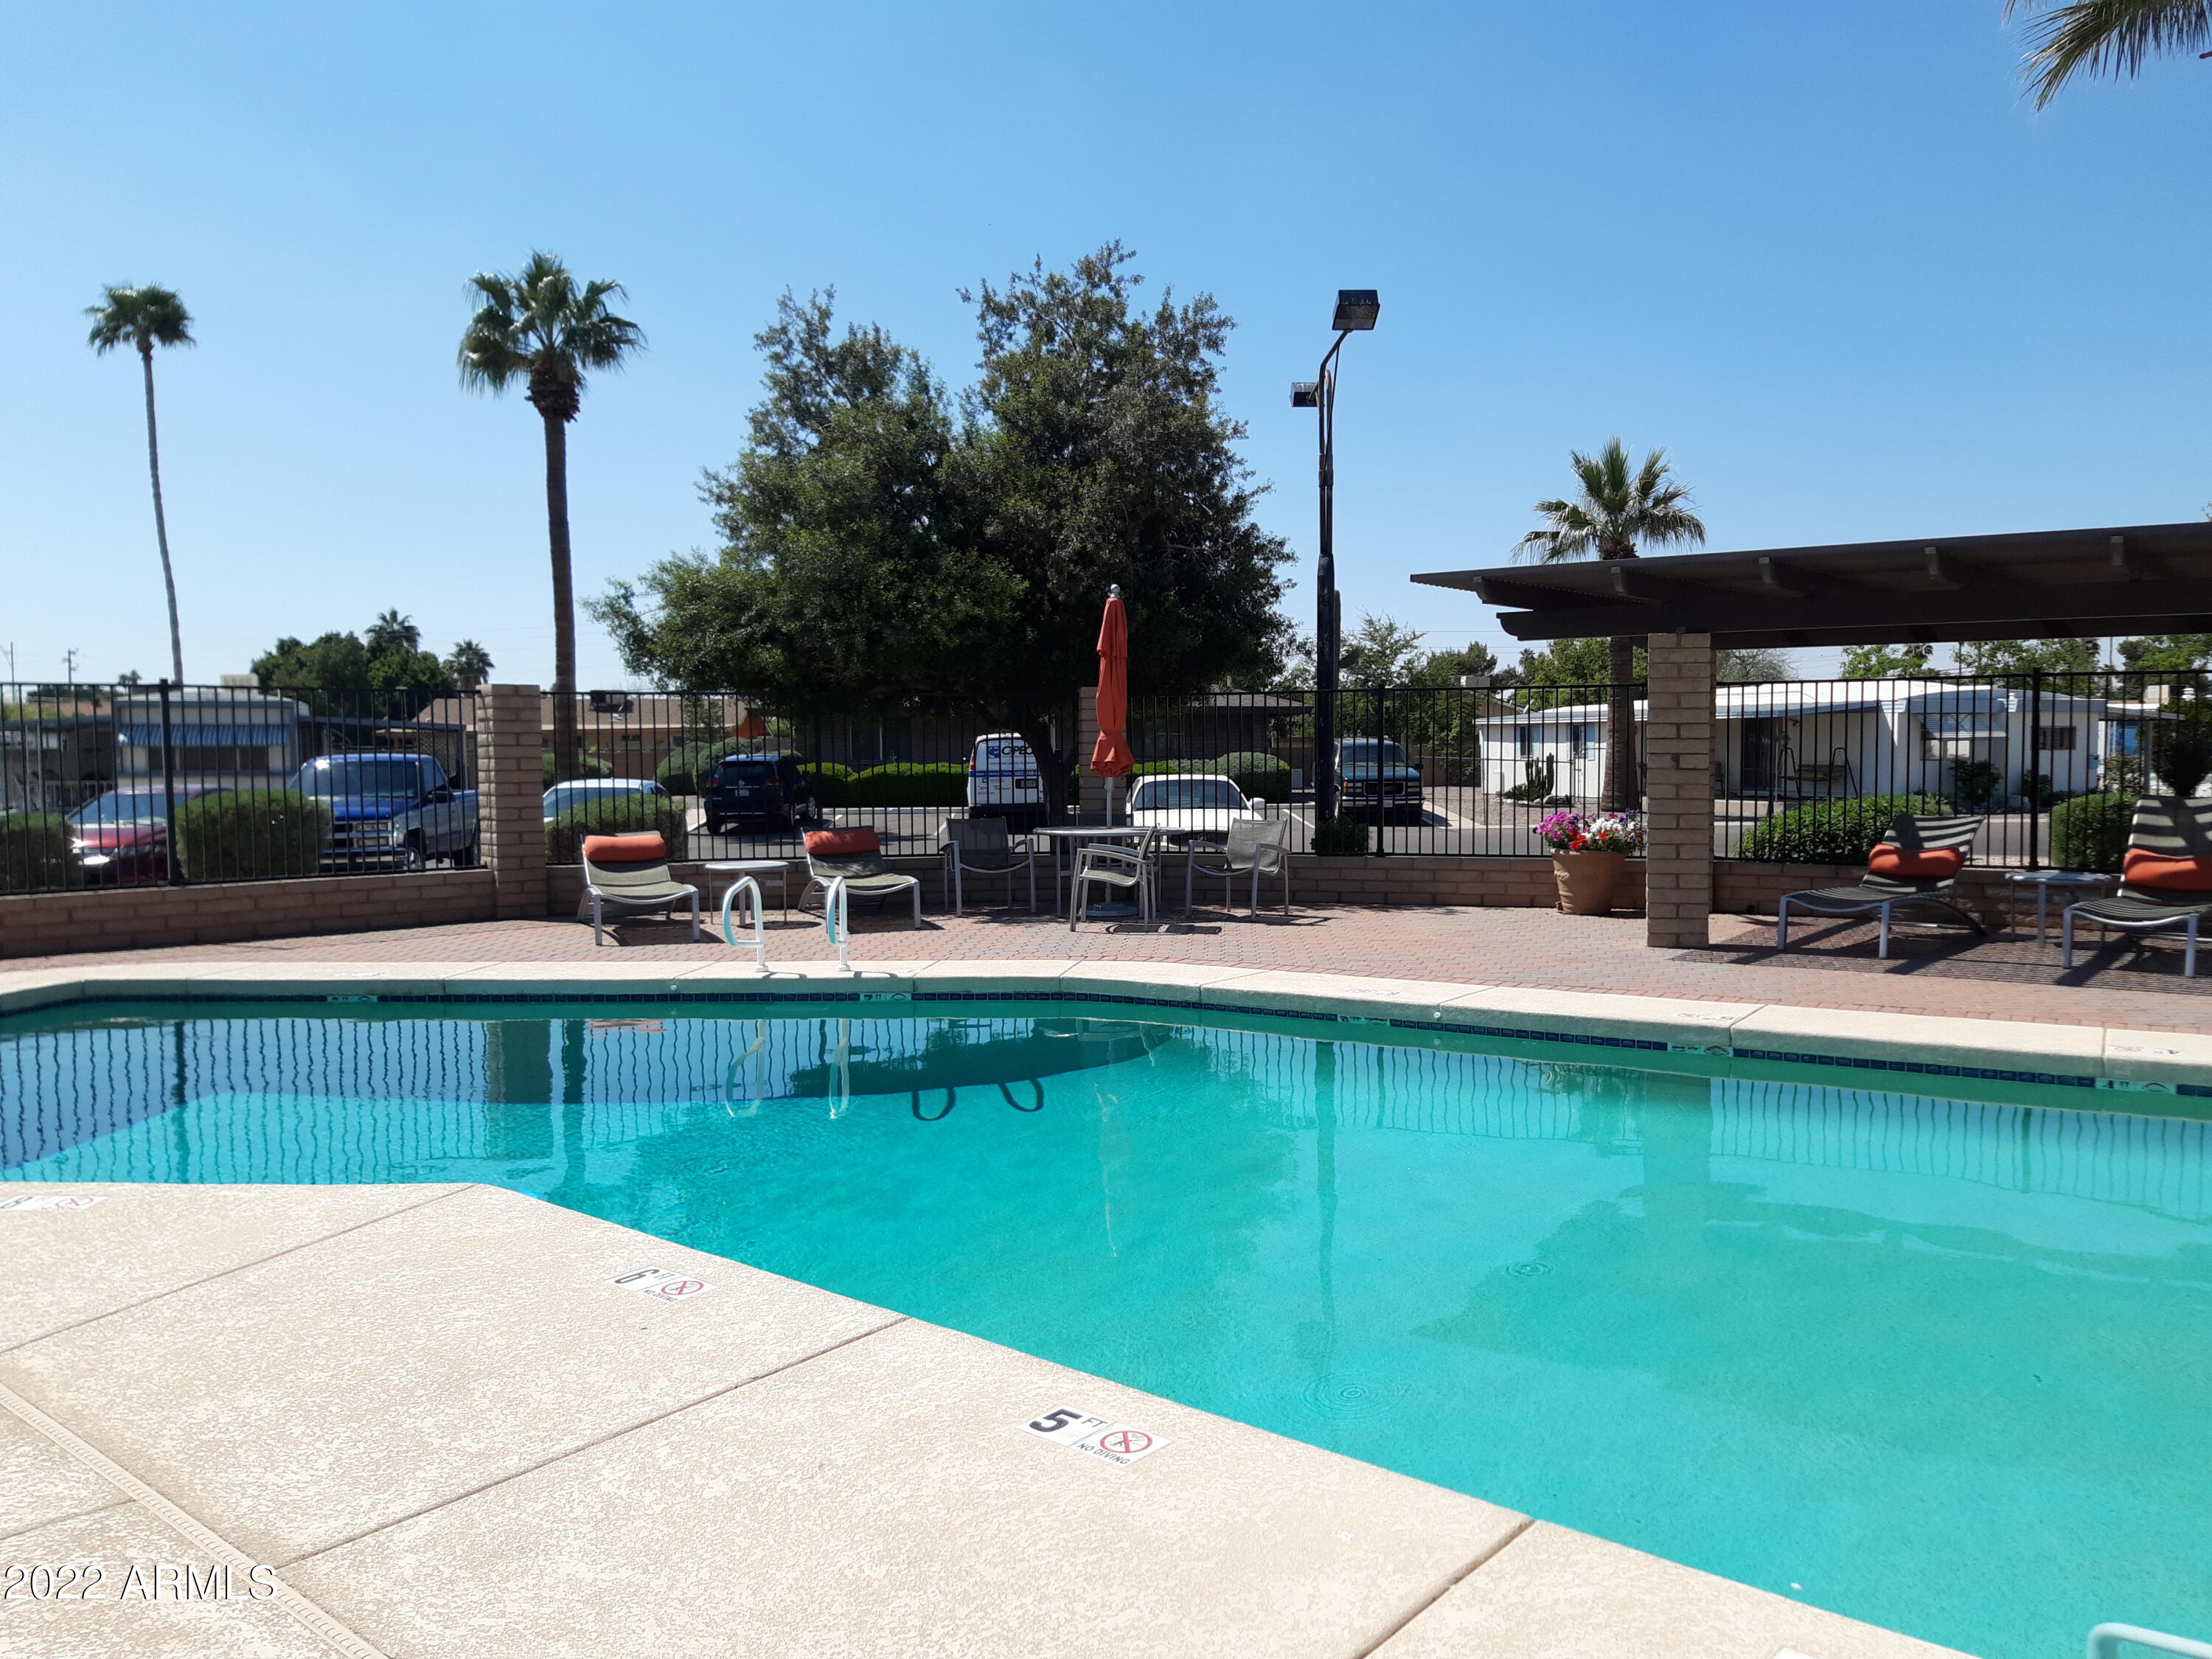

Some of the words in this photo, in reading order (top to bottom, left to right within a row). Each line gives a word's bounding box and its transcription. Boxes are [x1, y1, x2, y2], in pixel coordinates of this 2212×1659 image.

[614, 1269, 660, 1284] 6
[1029, 1408, 1083, 1432] 5
[1081, 1417, 1108, 1428] FT
[1077, 1442, 1094, 1452] NO
[1093, 1449, 1130, 1465] DIVING
